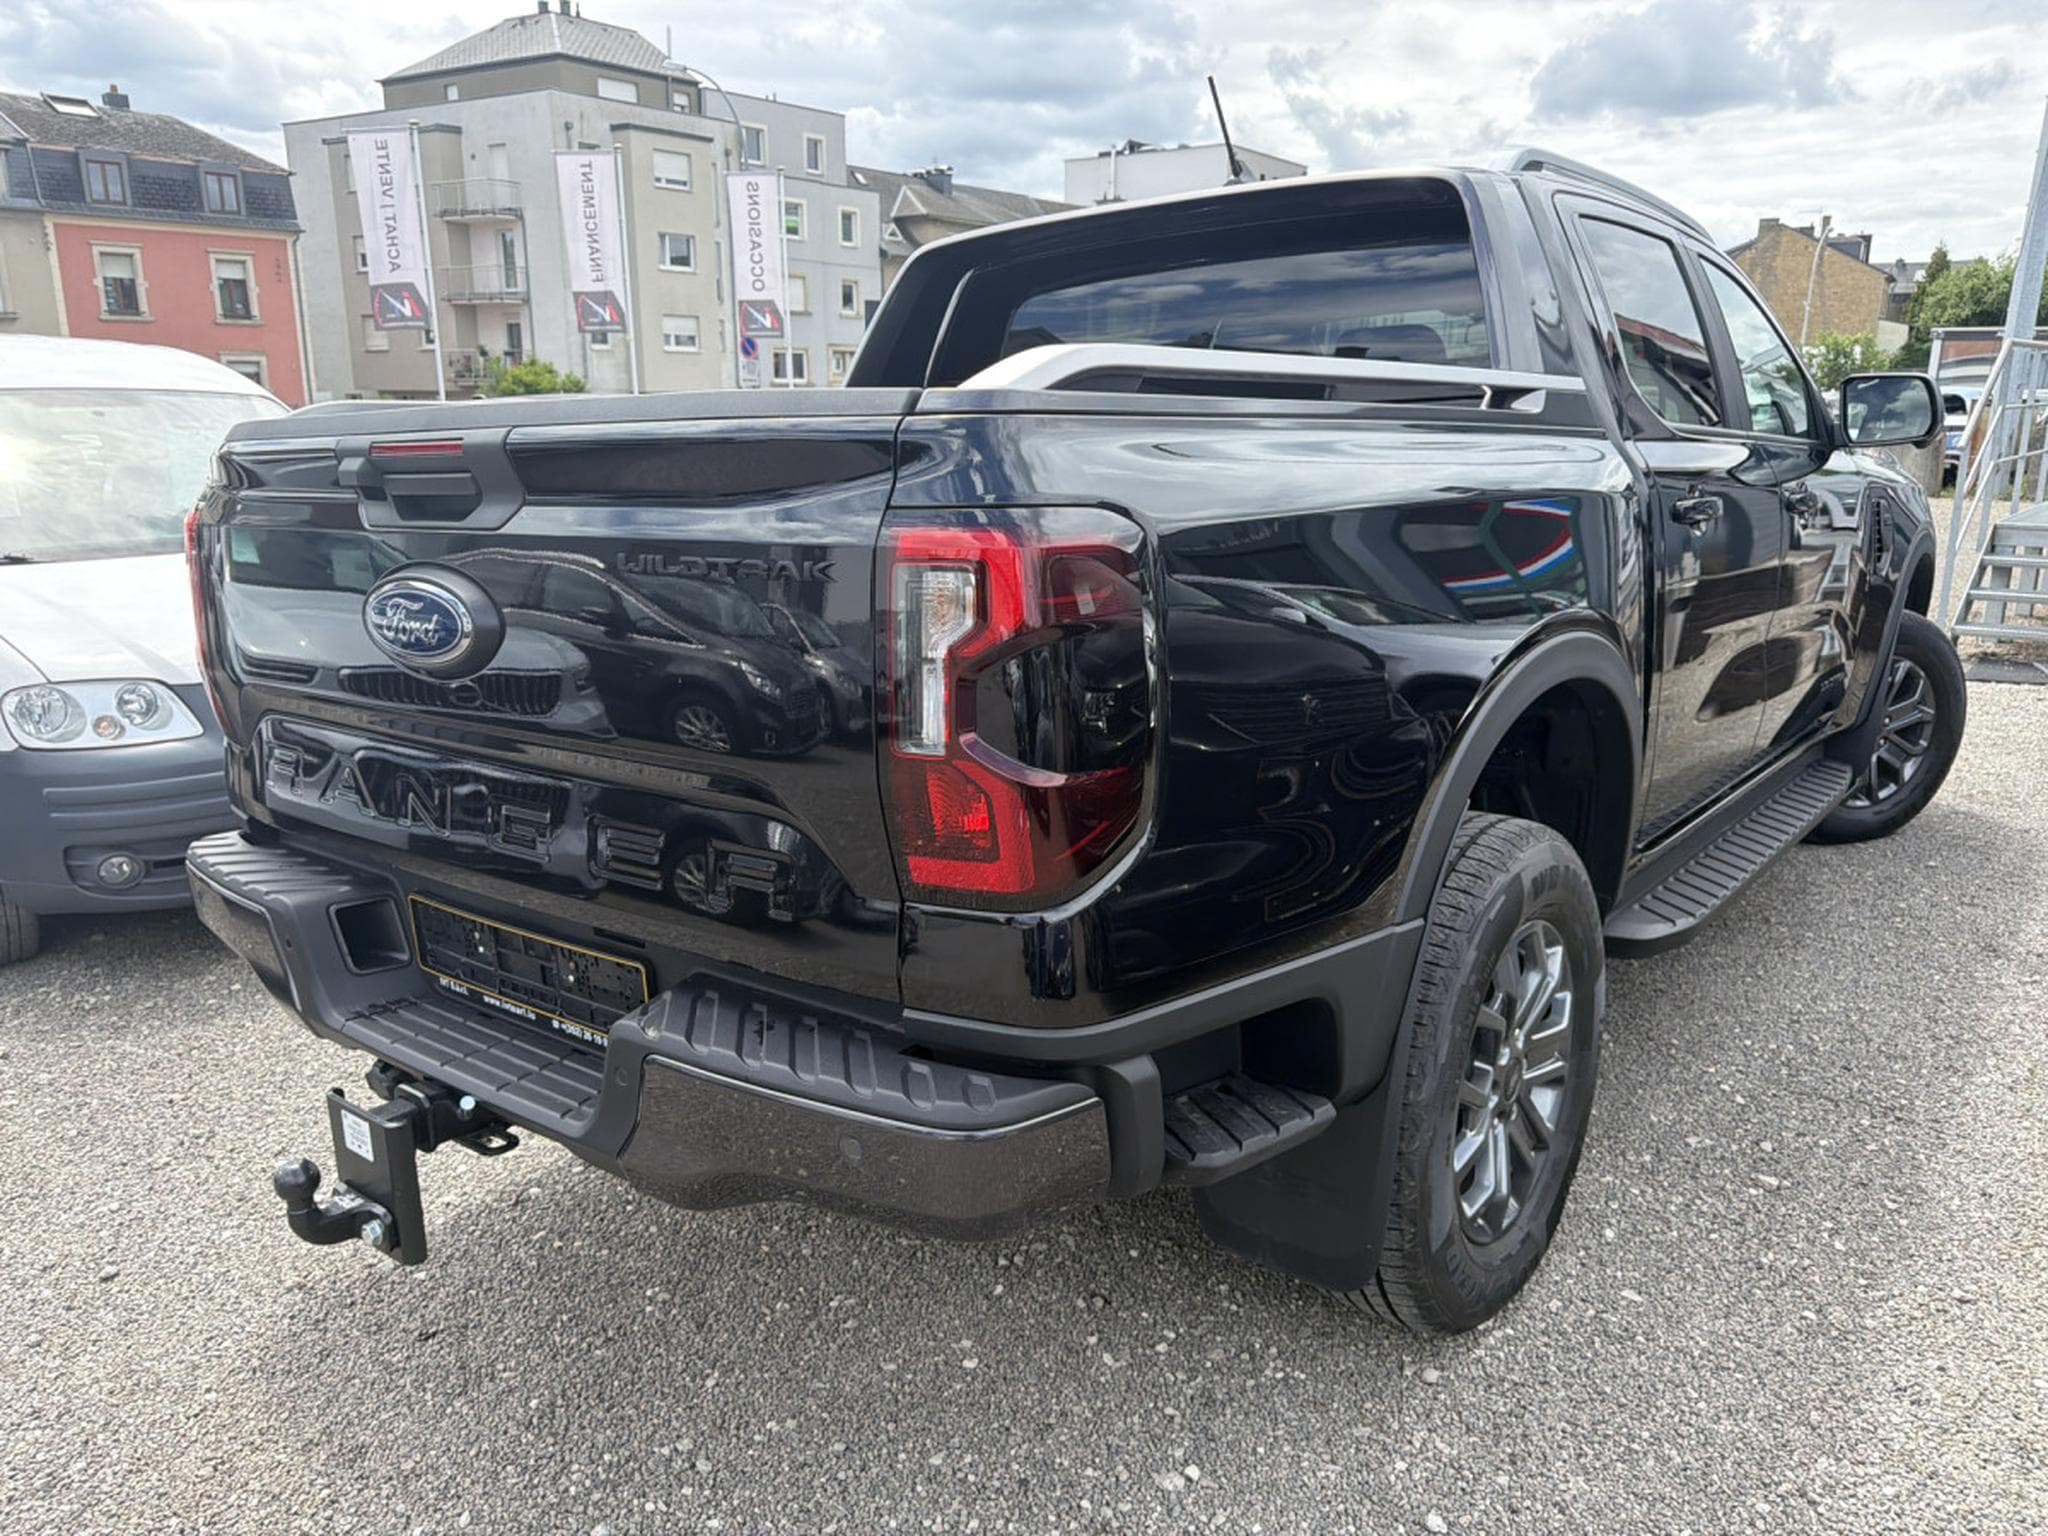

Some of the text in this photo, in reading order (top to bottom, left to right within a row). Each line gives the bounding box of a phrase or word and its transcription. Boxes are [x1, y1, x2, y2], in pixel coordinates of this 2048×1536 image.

[616, 552, 840, 584] WILDTRAK
[371, 597, 439, 647] Ford
[266, 745, 796, 924] RANGER
